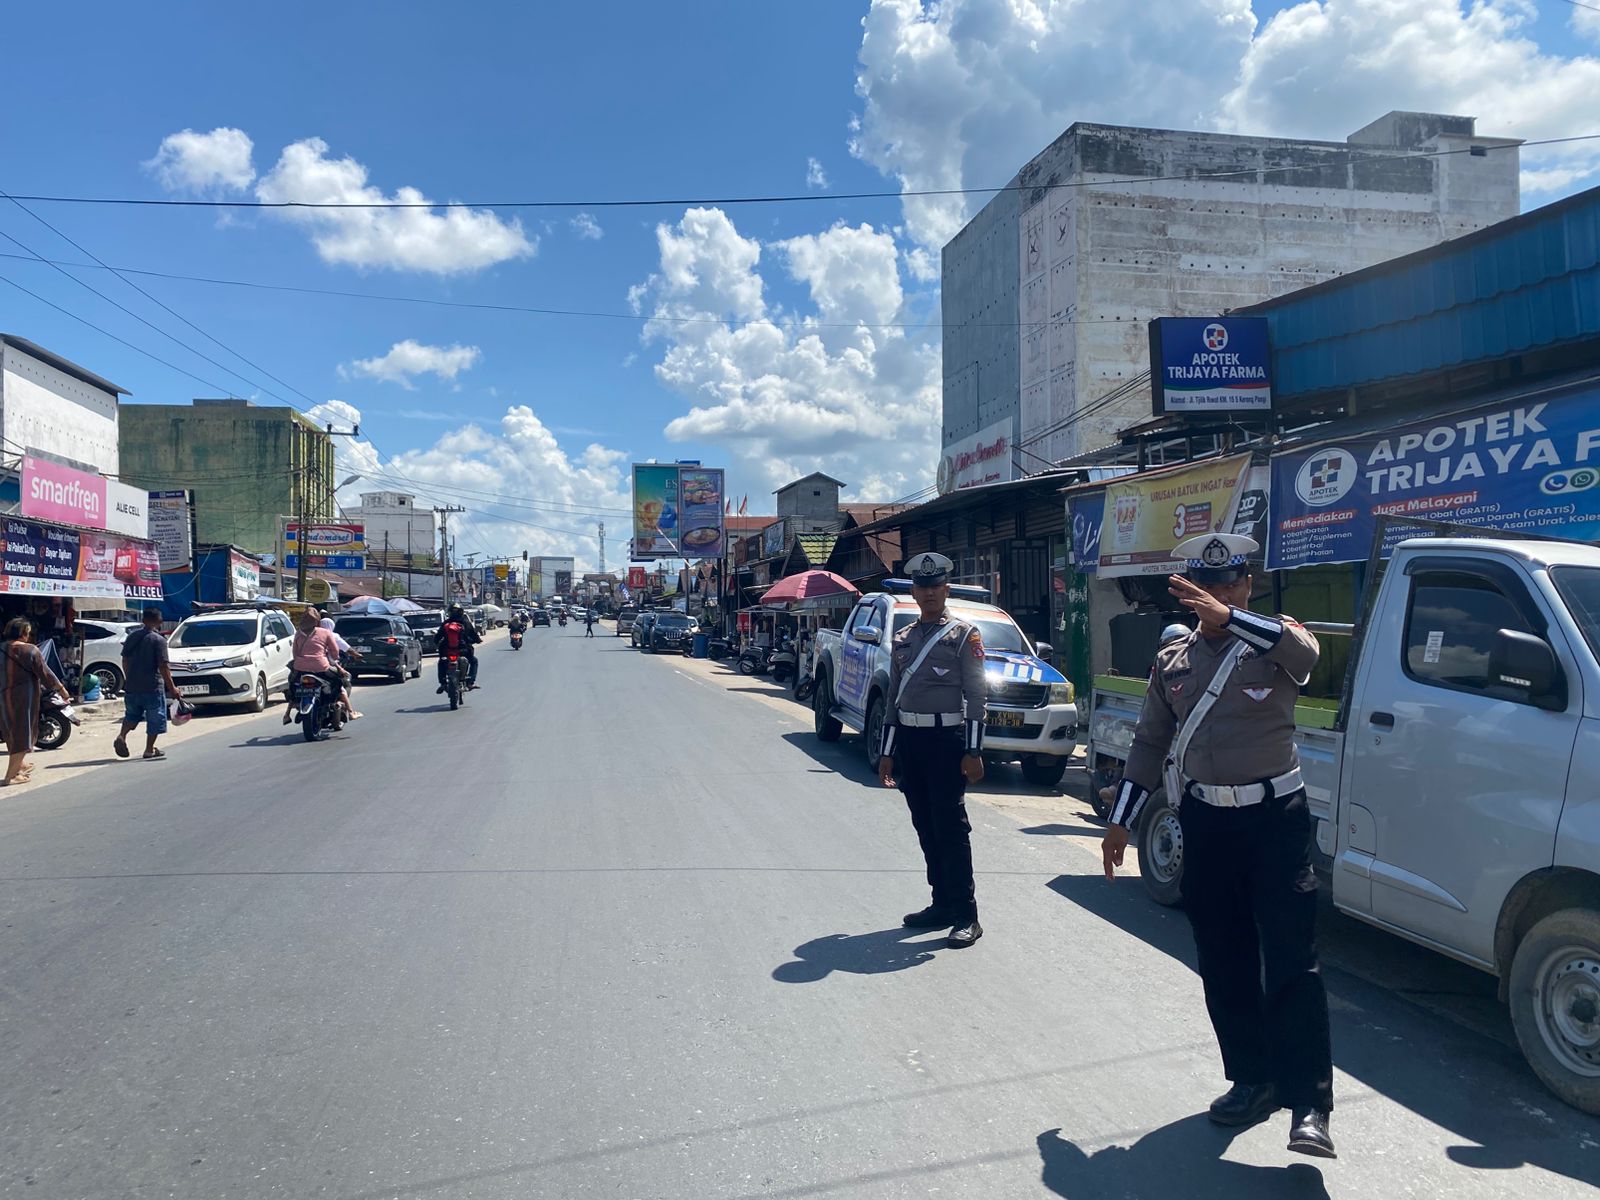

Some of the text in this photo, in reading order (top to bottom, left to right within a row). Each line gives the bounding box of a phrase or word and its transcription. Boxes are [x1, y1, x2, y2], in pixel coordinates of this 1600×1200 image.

[1192, 353, 1240, 365] APOTEK
[1168, 366, 1266, 378] TRIJAYA FARMA
[1366, 402, 1551, 465] APOTEK
[1364, 438, 1561, 495] TRIJAYA
[31, 476, 99, 513] smartfren
[1309, 486, 1338, 496] APOTEK
[116, 502, 128, 514] ALIE
[128, 505, 140, 517] CELL
[1407, 491, 1478, 510] Melayani
[1429, 511, 1453, 519] Obat
[1455, 502, 1501, 517] (GRATIS)
[1487, 511, 1520, 522] Darah
[1523, 503, 1576, 519] (GRATIS)
[1173, 502, 1186, 540] 3
[1503, 520, 1535, 529] Asam
